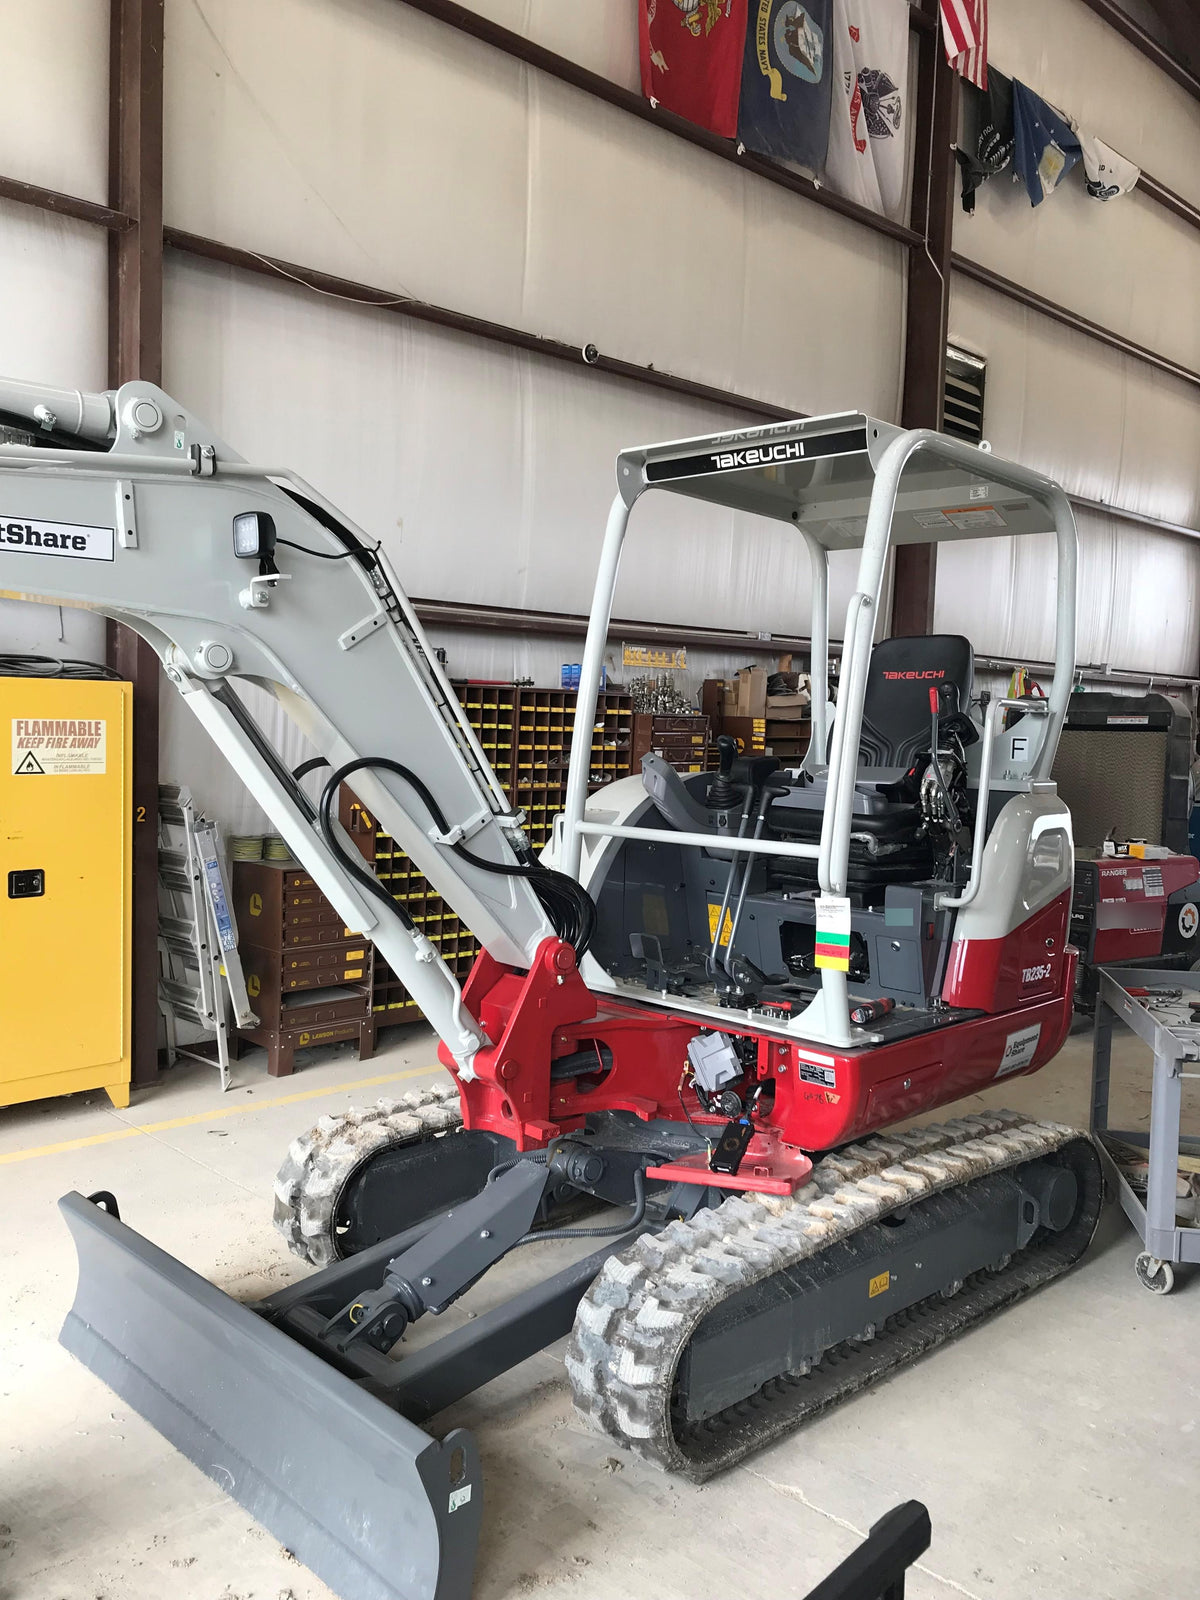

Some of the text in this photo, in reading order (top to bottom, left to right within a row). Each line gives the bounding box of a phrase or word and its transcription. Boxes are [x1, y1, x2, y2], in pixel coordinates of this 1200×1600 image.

[758, 17, 768, 45] STATES
[759, 50, 770, 71] NAVY
[710, 441, 805, 469] TAKEUCHI
[882, 670, 945, 680] TAKEUCHI
[16, 720, 102, 736] FLAMMABLE
[17, 737, 101, 749] KEEP FIRE AWAY
[1011, 738, 1027, 759] F
[136, 806, 146, 822] 2
[1101, 869, 1127, 877] RANGER
[1022, 963, 1051, 983] TB235-2
